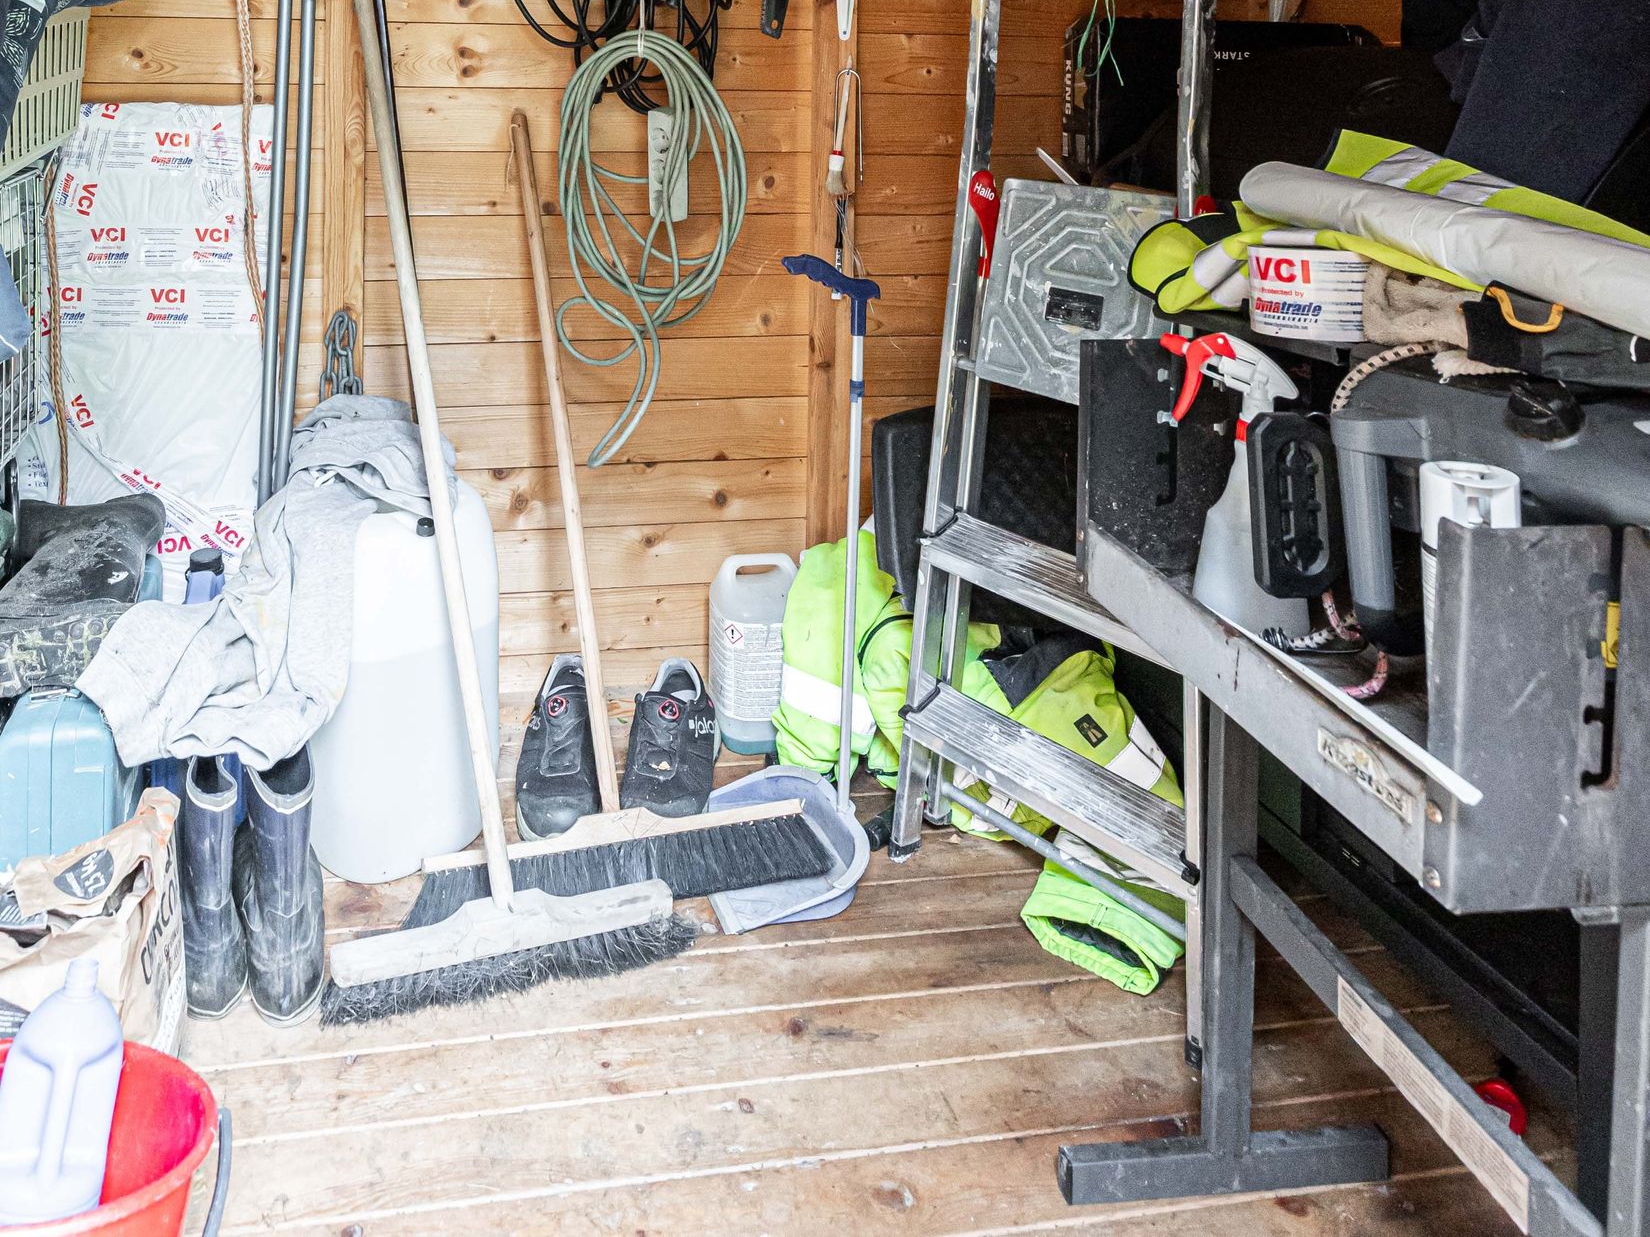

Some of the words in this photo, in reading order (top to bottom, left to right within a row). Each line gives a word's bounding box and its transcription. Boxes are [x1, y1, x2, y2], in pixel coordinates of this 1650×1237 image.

[155, 132, 190, 147] VCI
[973, 181, 996, 201] Hailo
[76, 183, 98, 217] VCI
[90, 227, 126, 242] VCI
[195, 228, 229, 242] VCI
[87, 252, 129, 262] Dynatrade
[1255, 256, 1311, 284] VCI
[150, 288, 186, 303] VCI
[1259, 287, 1293, 296] Protected
[1295, 290, 1304, 298] by
[1255, 297, 1322, 316] Dynatrade
[146, 313, 189, 322] Dynatrade
[71, 394, 95, 429] VCI
[215, 520, 246, 549] VCI
[156, 535, 192, 555] VCI
